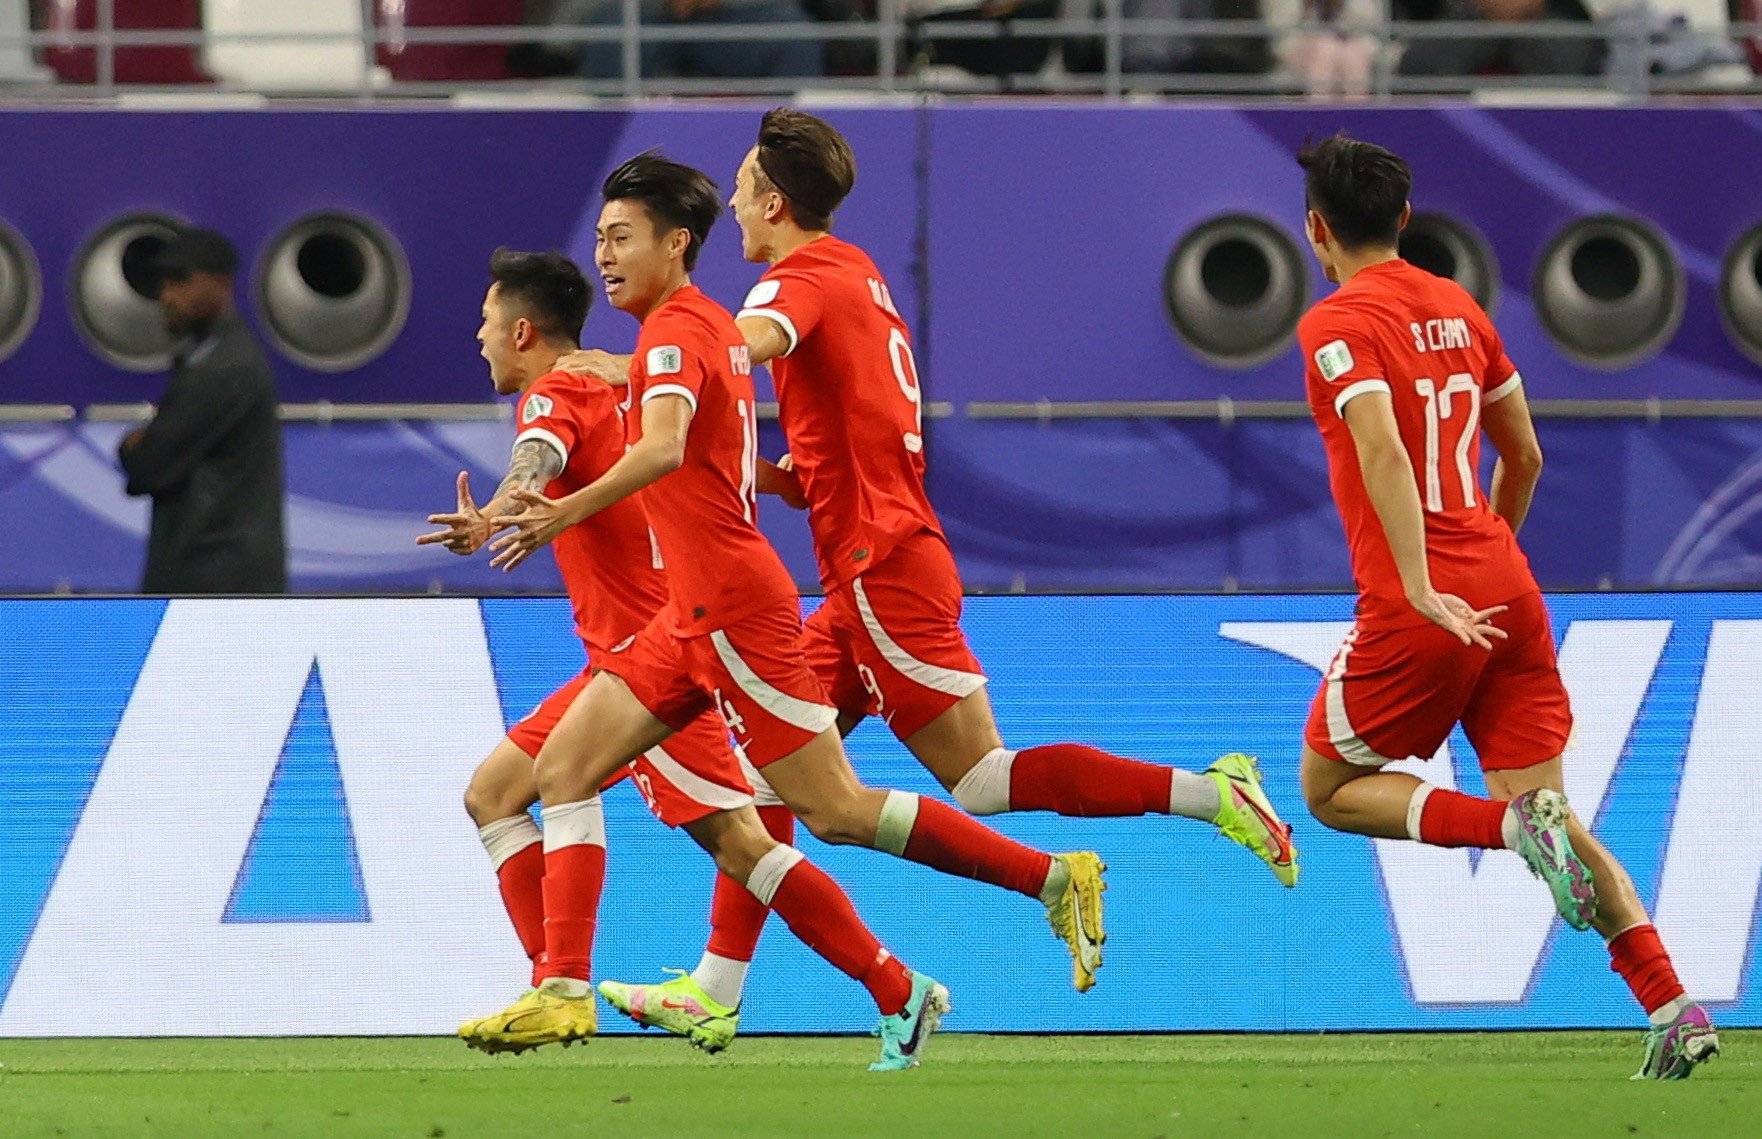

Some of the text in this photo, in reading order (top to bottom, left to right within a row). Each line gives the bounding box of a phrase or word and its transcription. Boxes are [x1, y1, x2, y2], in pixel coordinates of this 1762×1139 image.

[1410, 321, 1427, 353] S
[887, 325, 924, 454] 9
[1414, 372, 1481, 513] 17
[857, 663, 885, 712] 9
